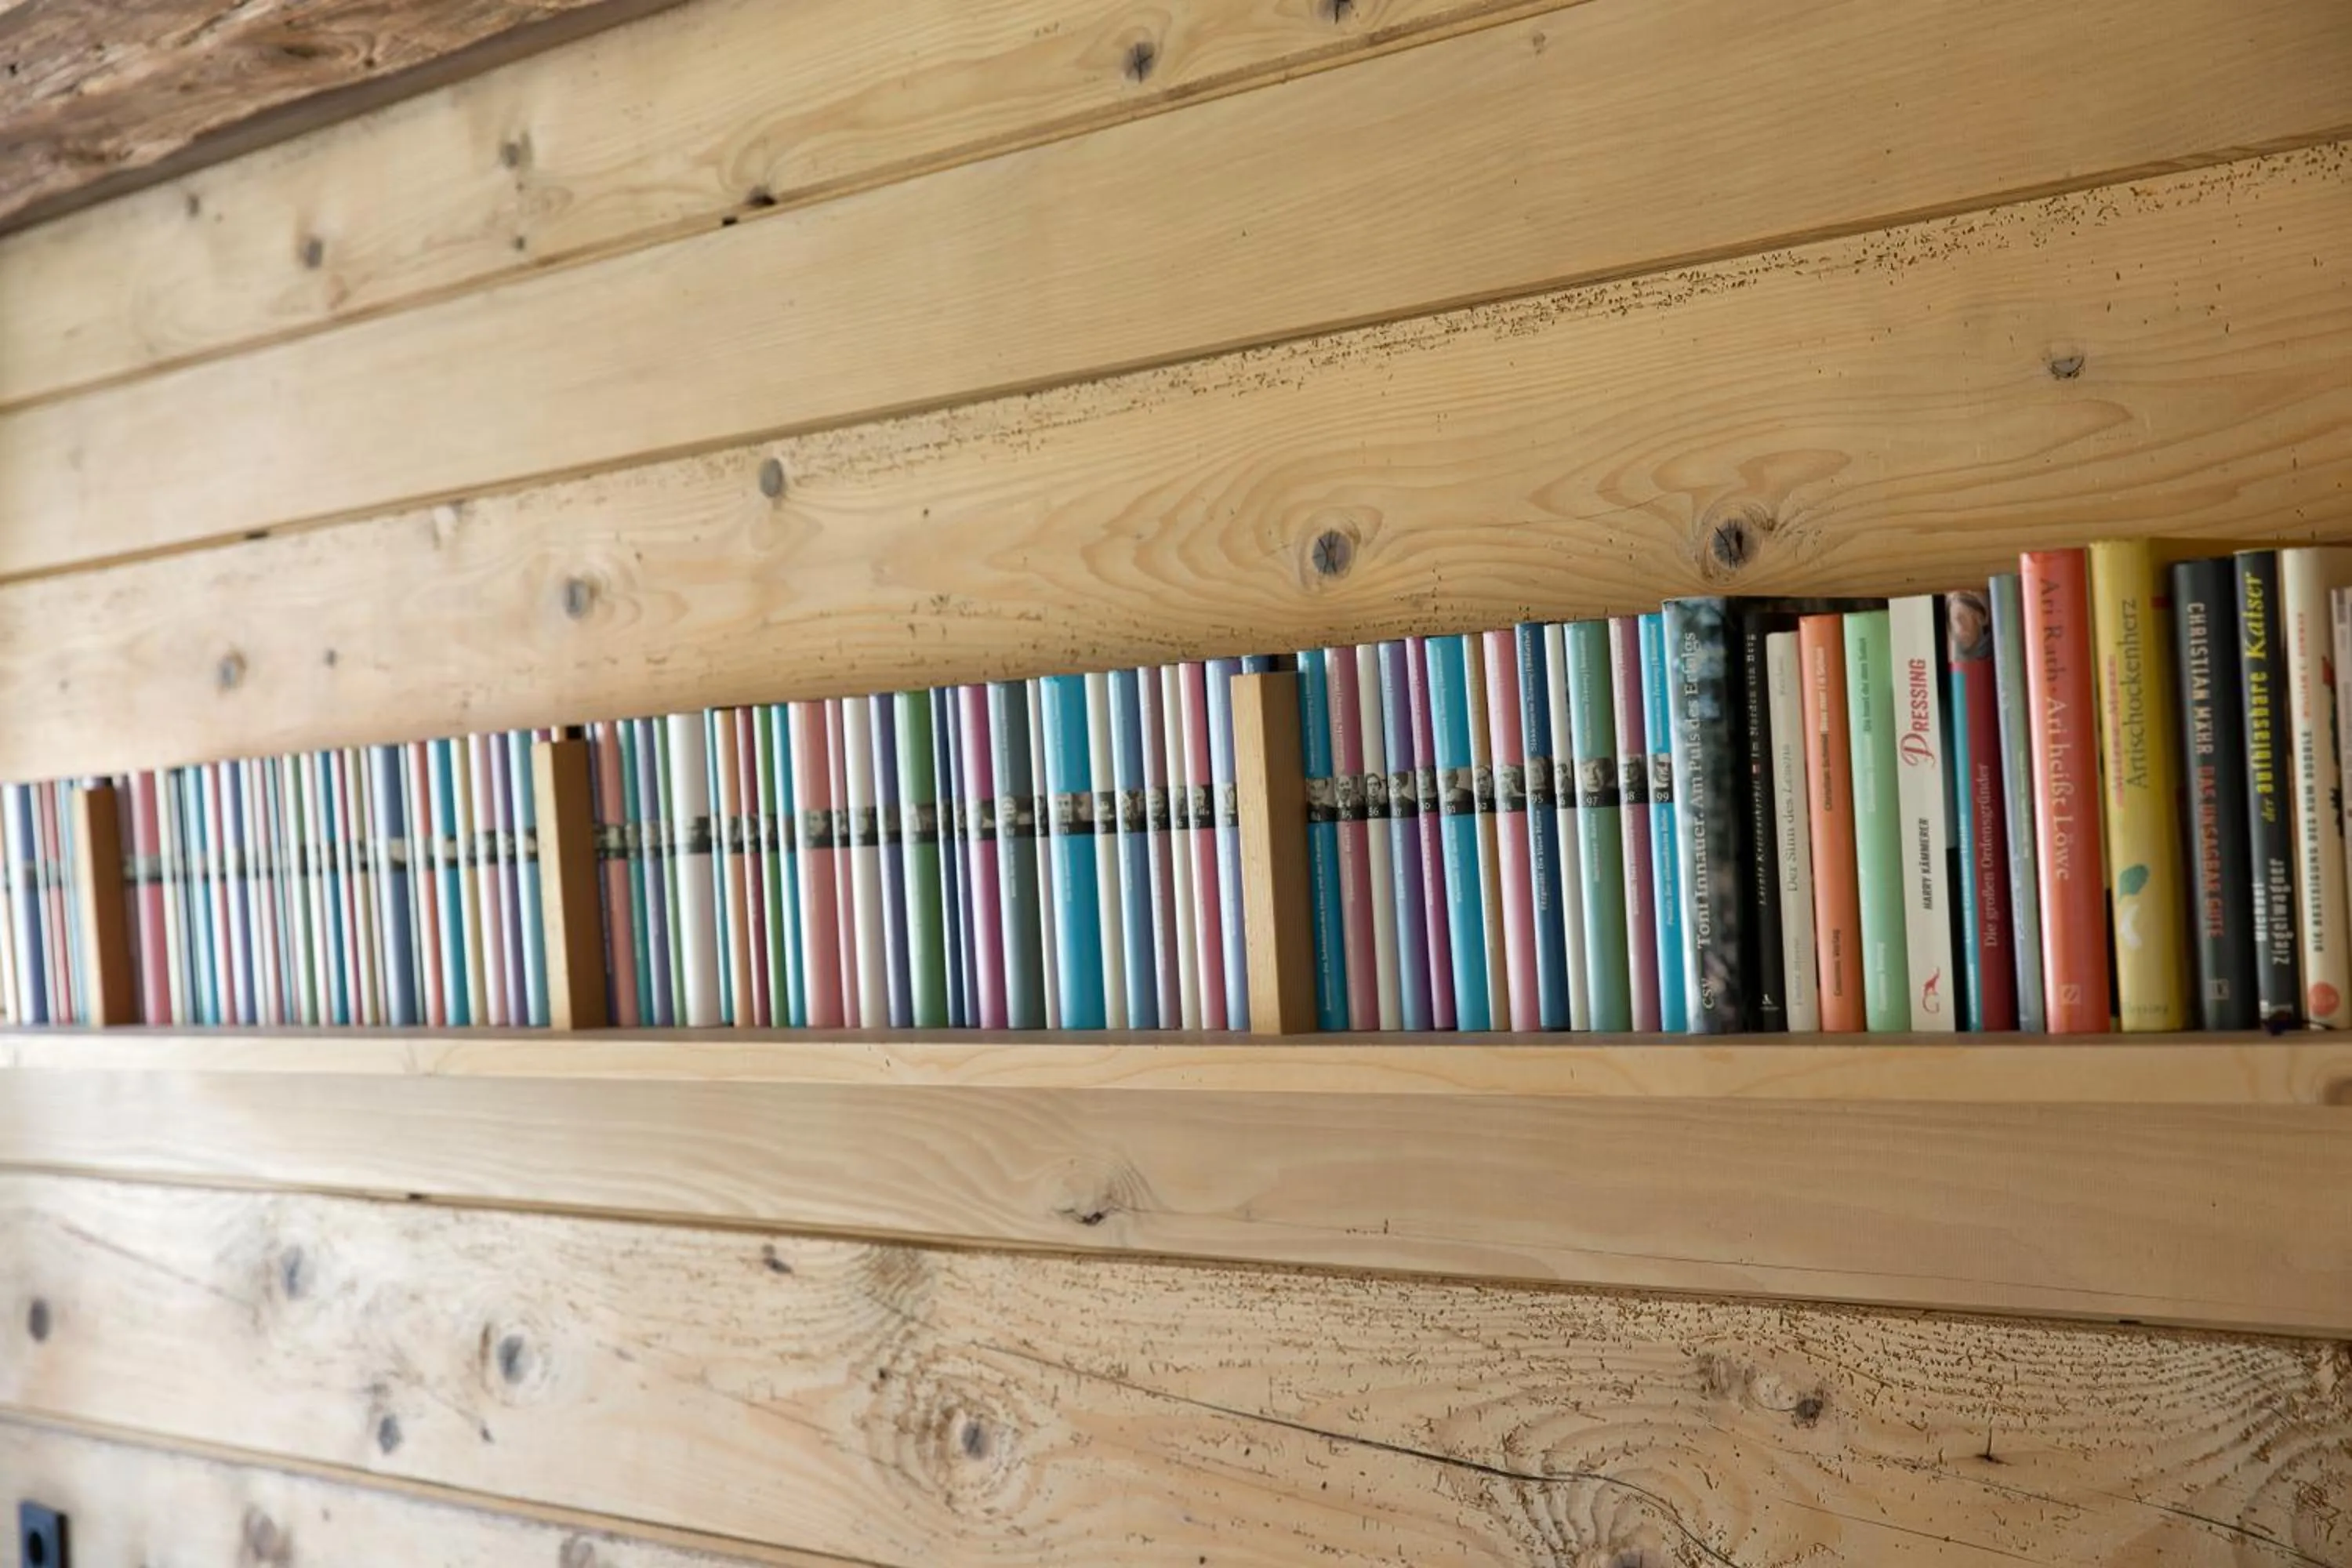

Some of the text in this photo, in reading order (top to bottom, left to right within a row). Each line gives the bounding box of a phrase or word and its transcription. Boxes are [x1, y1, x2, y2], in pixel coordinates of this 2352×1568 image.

[2040, 577, 2067, 683] Ari Rath
[2187, 602, 2211, 700] CHRISTIAN
[2115, 599, 2149, 789] Artischockenherz
[2241, 571, 2275, 822] der aufblasbare Kaiser
[1532, 793, 1544, 804] 95
[1586, 796, 1599, 807] 97
[1656, 791, 1669, 801] 99
[1681, 632, 1711, 949] Toni Innauer. Am Puls des Erfolgs
[1782, 798, 1795, 824] des
[2046, 695, 2074, 880] Ari heißt Löwe
[1784, 828, 1797, 863] Sinn
[1786, 866, 1798, 892] Der
[1918, 818, 1933, 910] HARRY KÄMMERER
[1976, 762, 1998, 947] Die großen Ordensgründer
[2268, 858, 2294, 966] Ziegelwagner
